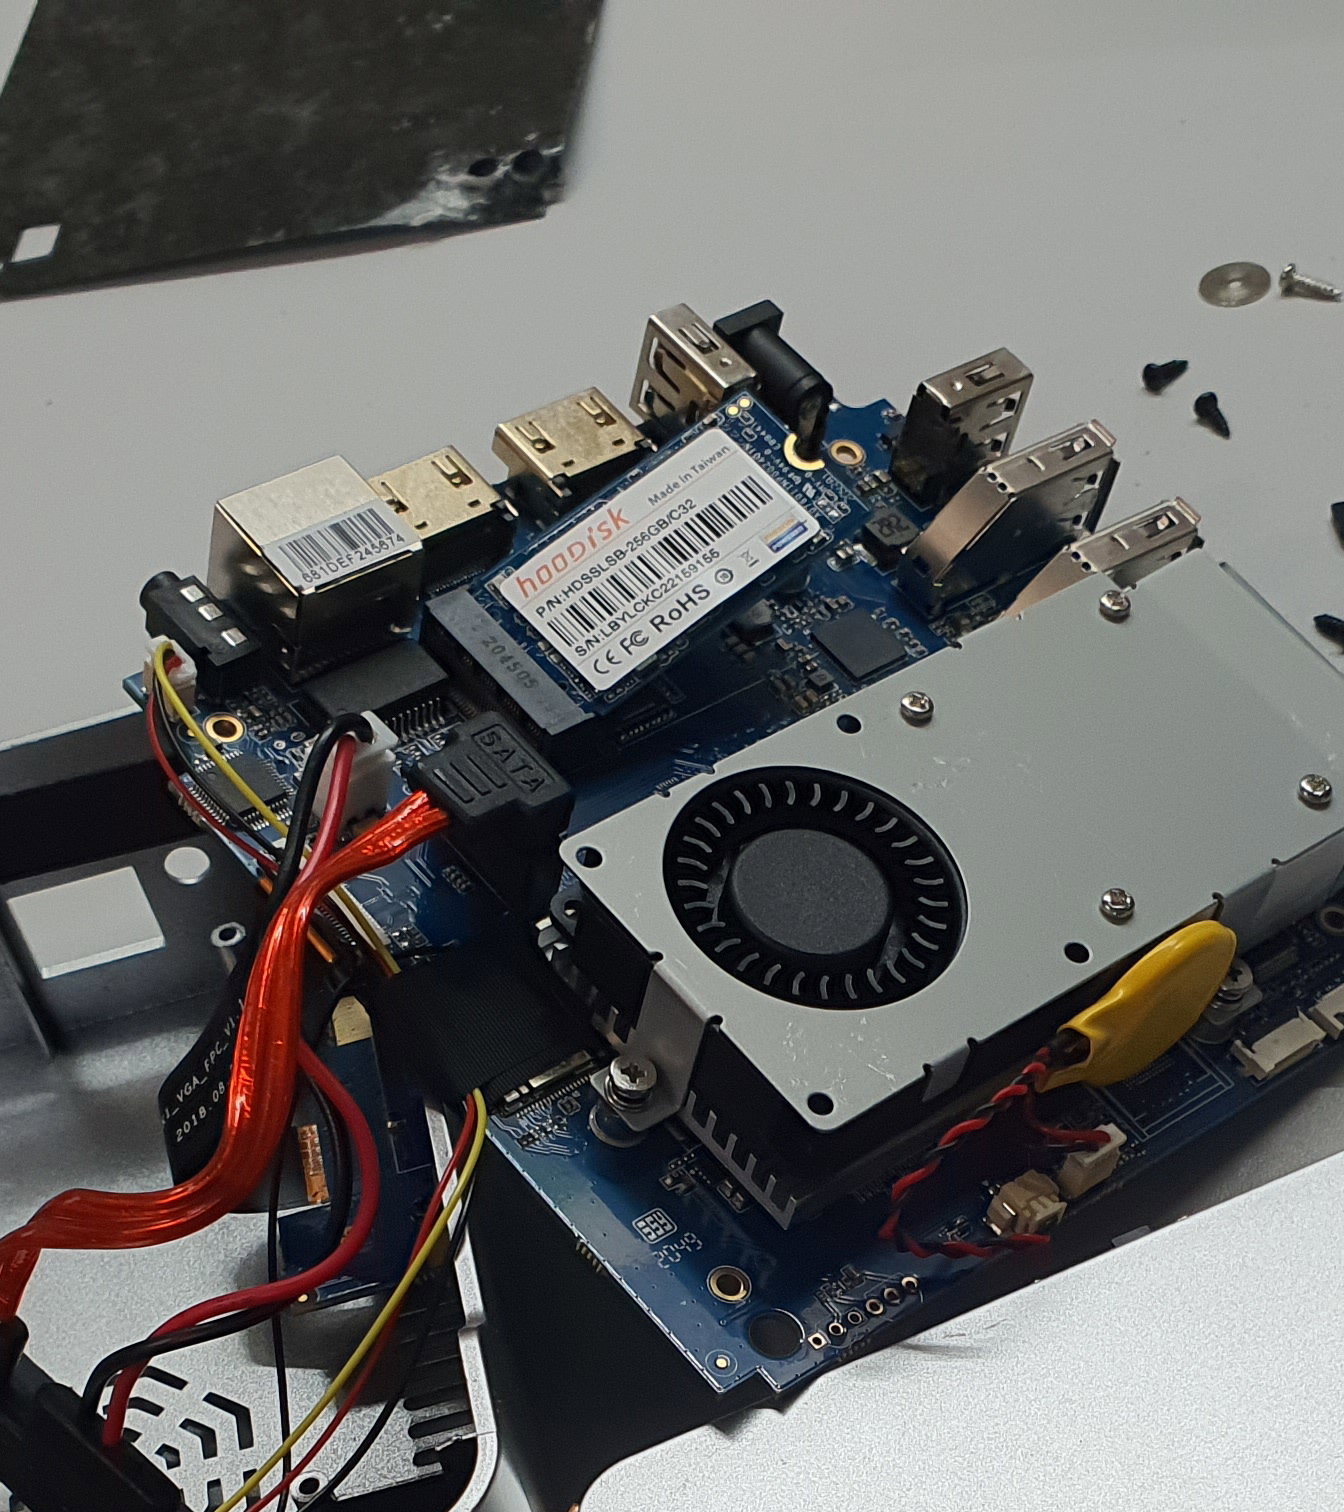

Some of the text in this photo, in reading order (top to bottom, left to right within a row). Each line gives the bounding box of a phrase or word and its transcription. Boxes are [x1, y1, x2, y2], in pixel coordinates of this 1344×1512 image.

[648, 482, 681, 506] Made
[690, 445, 731, 474] Taiwan
[649, 584, 711, 633] RoHS
[480, 730, 545, 793] SATA
[652, 1232, 703, 1269] 2049
